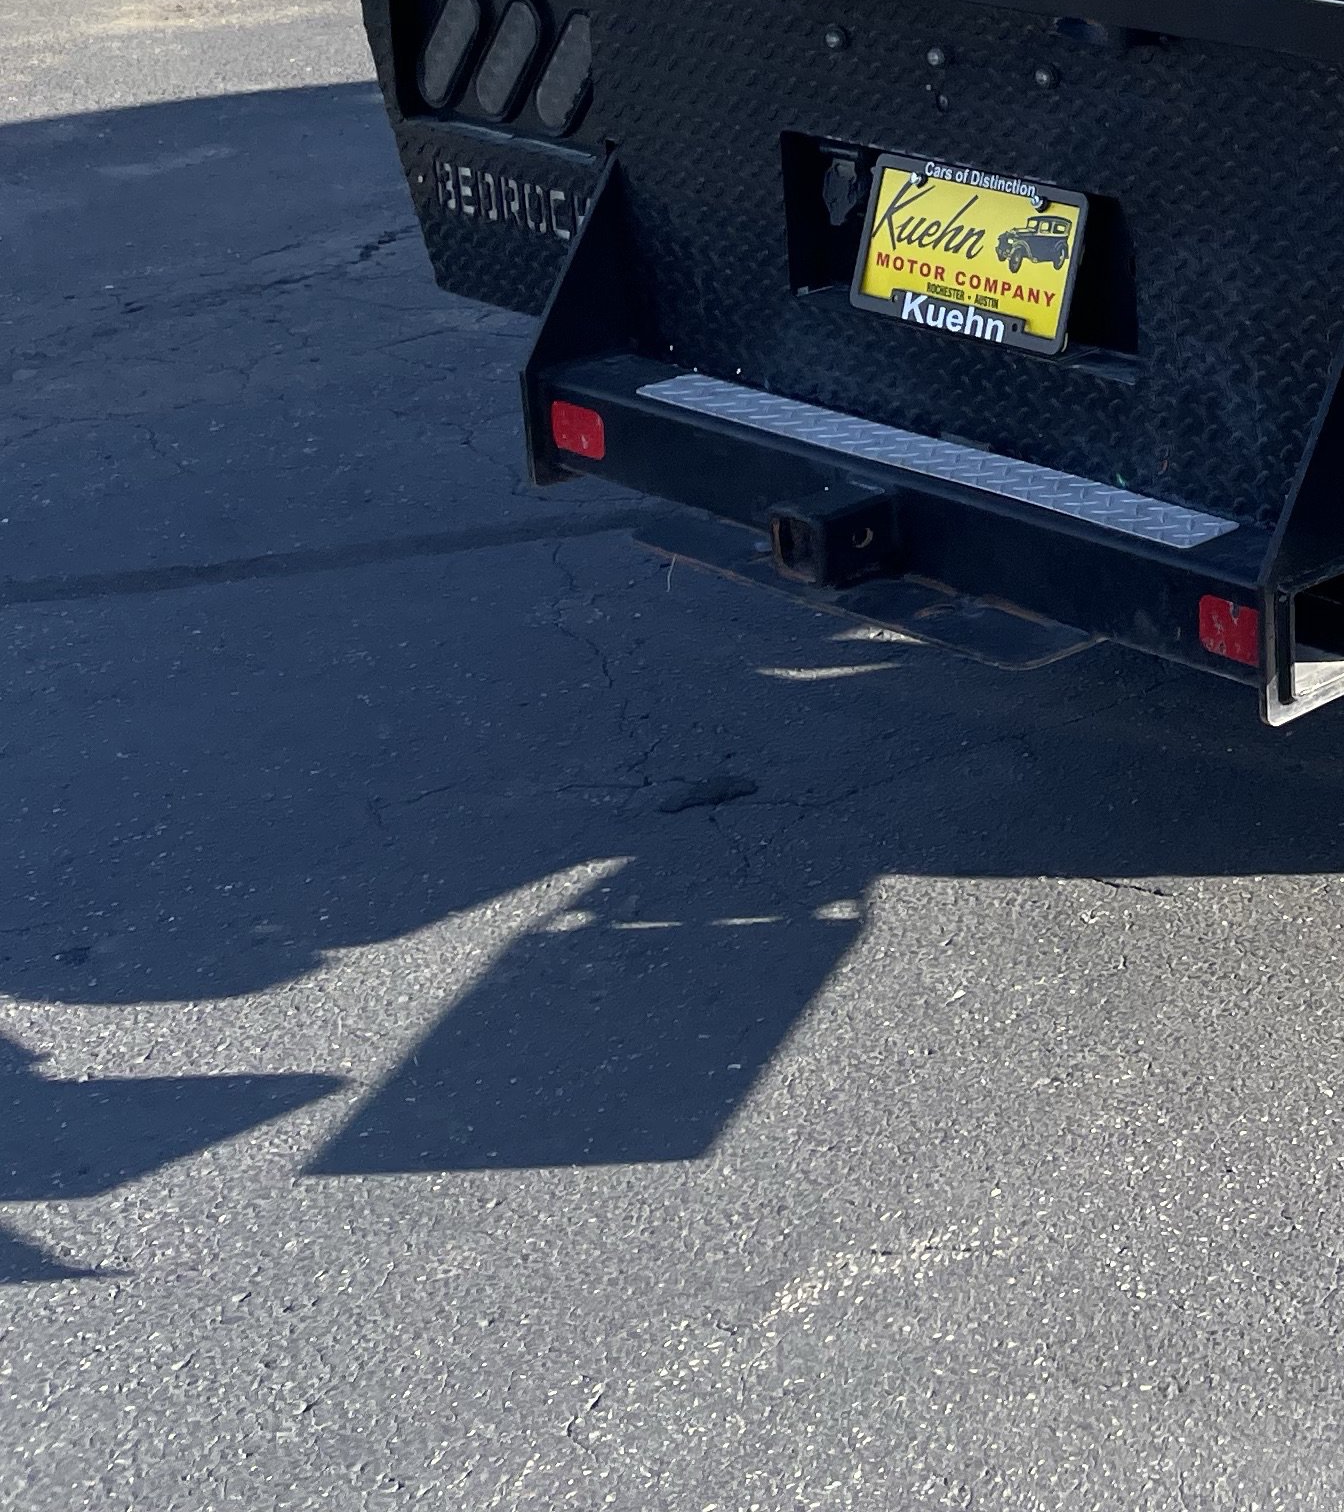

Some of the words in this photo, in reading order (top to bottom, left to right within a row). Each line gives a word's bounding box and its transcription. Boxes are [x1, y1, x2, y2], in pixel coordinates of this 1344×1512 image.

[925, 161, 952, 181] Cars
[955, 168, 969, 184] of
[970, 171, 1036, 198] Distinction
[872, 180, 986, 260] Kuehn
[876, 251, 945, 282] MOTOR
[955, 271, 1056, 307] COMPANY
[926, 281, 965, 300] ROCHESTER
[974, 293, 1000, 309] AUSTIN
[901, 291, 1005, 343] Kuehn
